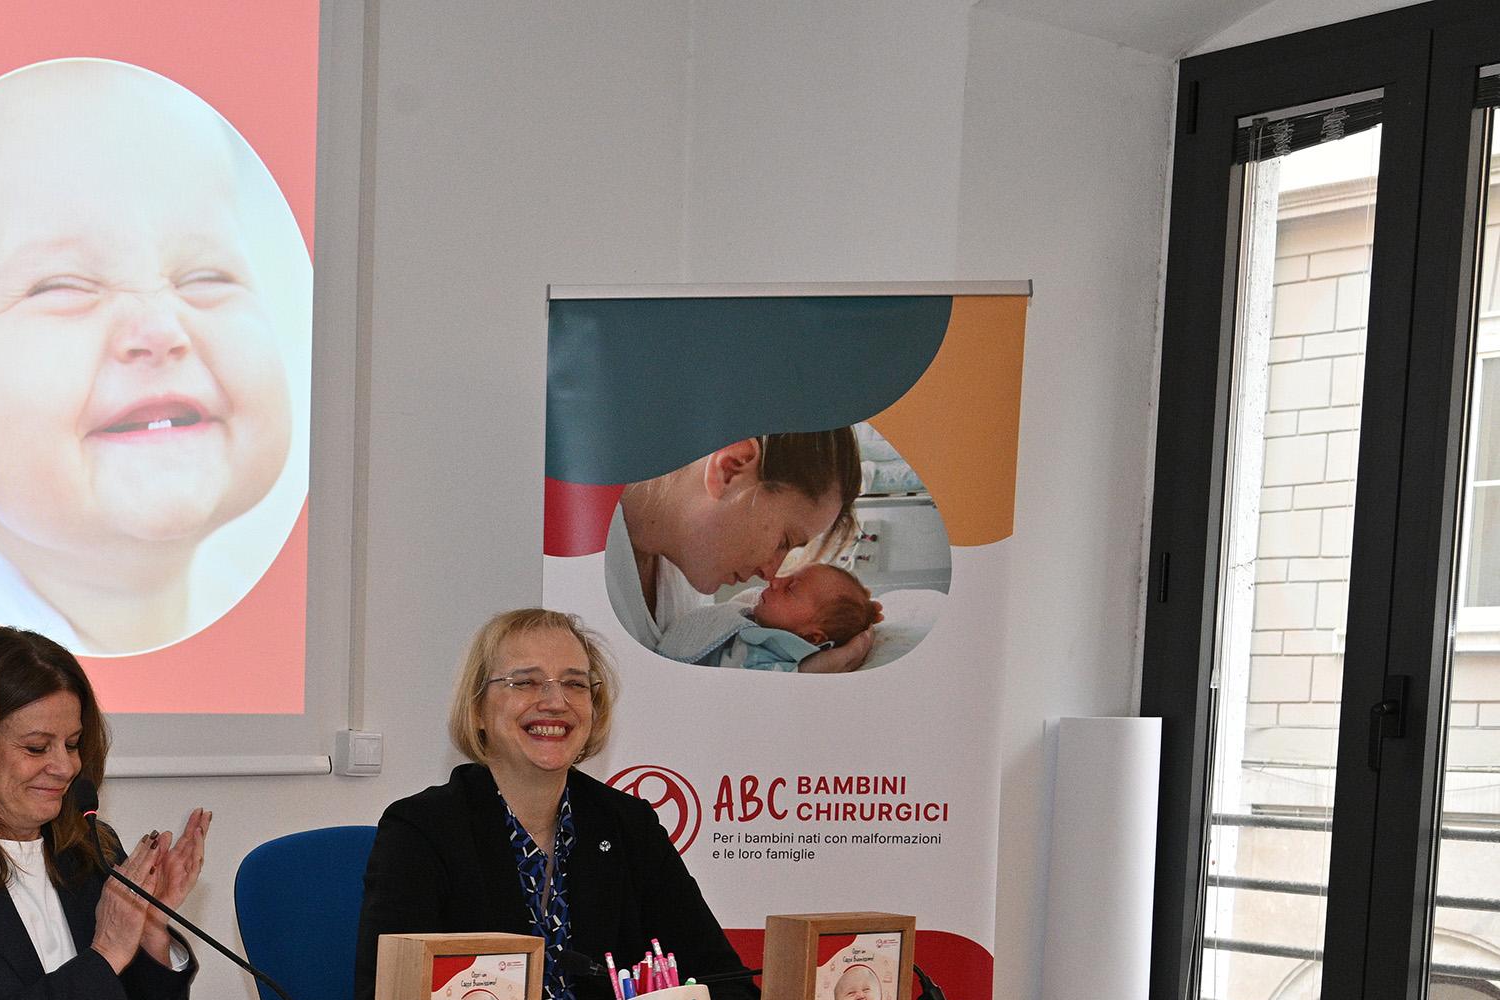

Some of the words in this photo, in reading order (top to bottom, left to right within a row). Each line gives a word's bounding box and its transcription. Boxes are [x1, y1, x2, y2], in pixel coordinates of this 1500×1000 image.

[796, 775, 907, 796] BAMBINI
[713, 774, 789, 823] ABC
[796, 802, 949, 822] CHIRURGICI
[713, 832, 735, 845] Per
[744, 832, 795, 845] bambini
[797, 832, 821, 845] nati
[824, 835, 848, 845] con
[851, 832, 942, 845] malformazioni
[712, 850, 720, 860] e
[723, 848, 735, 860] le
[737, 848, 763, 860] loro
[765, 847, 816, 863] famiglie
